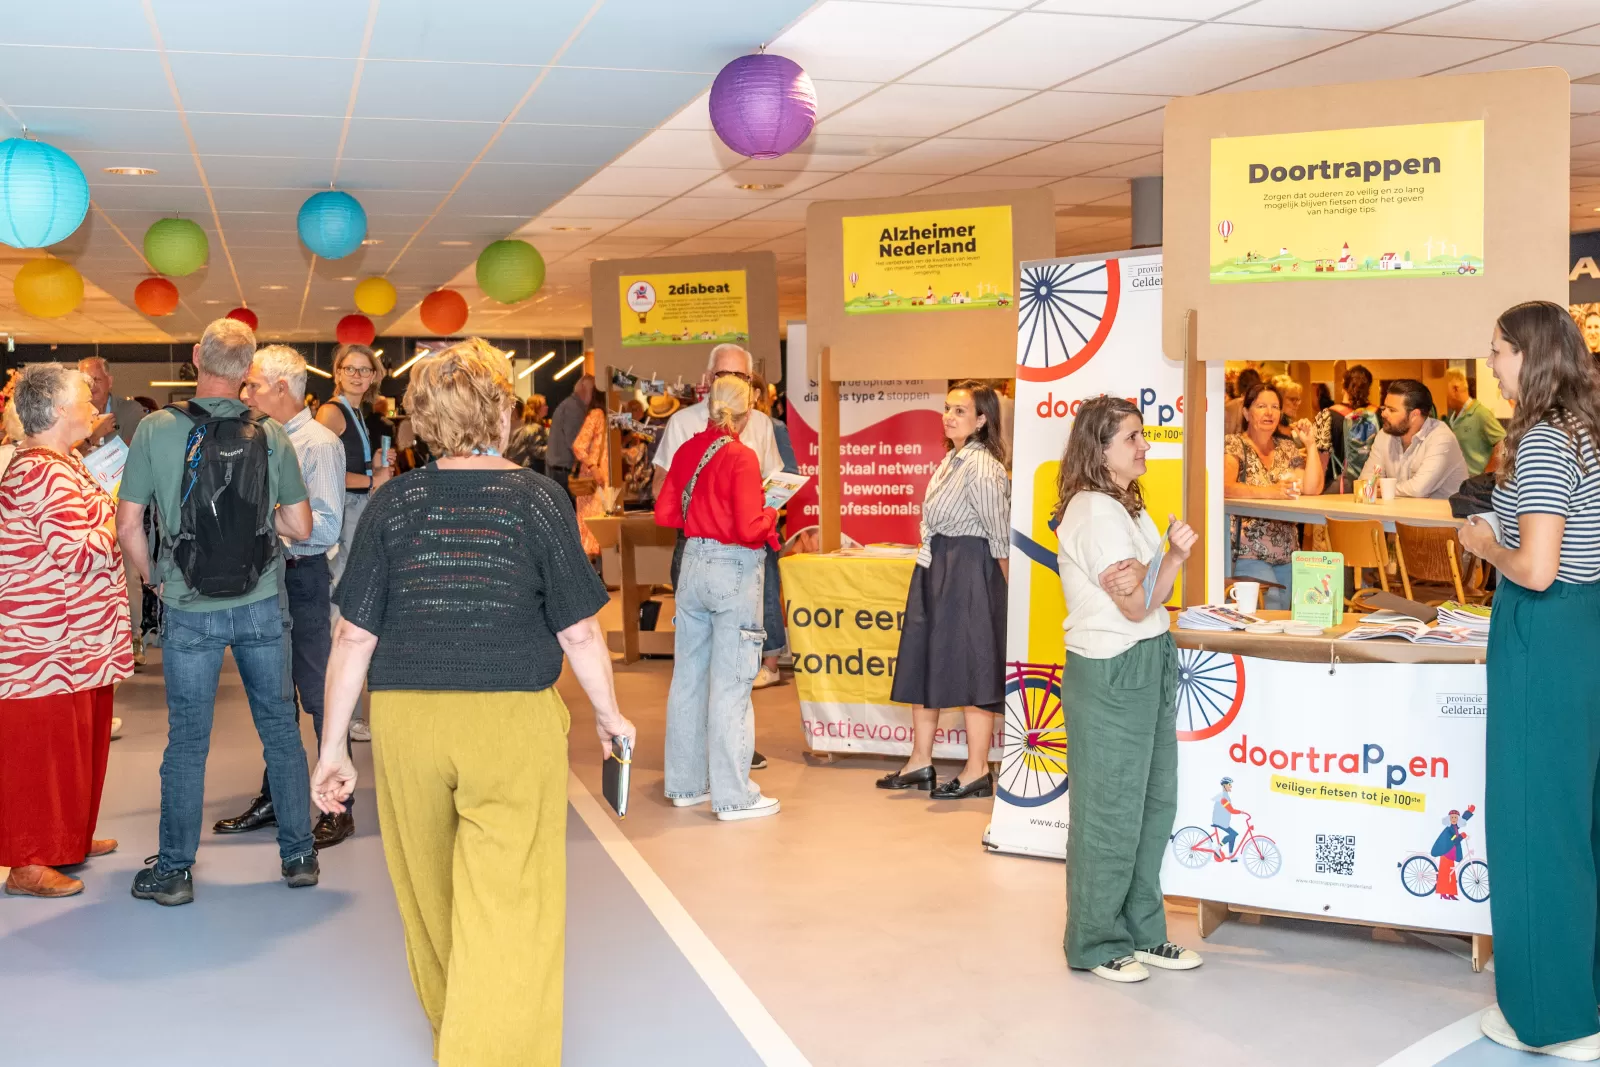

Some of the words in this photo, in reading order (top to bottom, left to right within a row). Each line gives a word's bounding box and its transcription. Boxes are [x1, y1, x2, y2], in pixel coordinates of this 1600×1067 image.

[1248, 156, 1442, 183] Doortrappen
[1263, 193, 1292, 202] Zorgen
[1356, 188, 1379, 197] veilig
[1405, 186, 1425, 195] lang
[1264, 201, 1299, 210] mogelijk
[1300, 199, 1327, 208] blijven
[1329, 198, 1357, 206] fietsen
[1380, 195, 1395, 203] het
[1396, 195, 1424, 204] geven
[1323, 206, 1358, 215] handige
[1359, 205, 1377, 214] tips.
[879, 223, 976, 242] Alzheimer
[879, 238, 977, 258] Nederland
[668, 283, 730, 296] 2diabeat
[852, 392, 875, 403] type
[877, 391, 885, 401] 2
[887, 391, 930, 403] stoppen
[1153, 429, 1162, 440] je
[809, 443, 876, 455] Insteer
[878, 441, 892, 455] in
[895, 443, 922, 455] een
[878, 462, 938, 475] netwerk
[843, 482, 914, 496] bewoners
[803, 504, 819, 516] en
[1295, 556, 1340, 565] doortrappen
[1446, 694, 1483, 704] provincie
[1228, 734, 1449, 790] doortrappen
[1275, 780, 1317, 796] veiliger
[1320, 785, 1358, 799] fietsen
[1361, 790, 1378, 801] tot
[1380, 792, 1391, 805] je
[1393, 794, 1421, 806] 100ste
